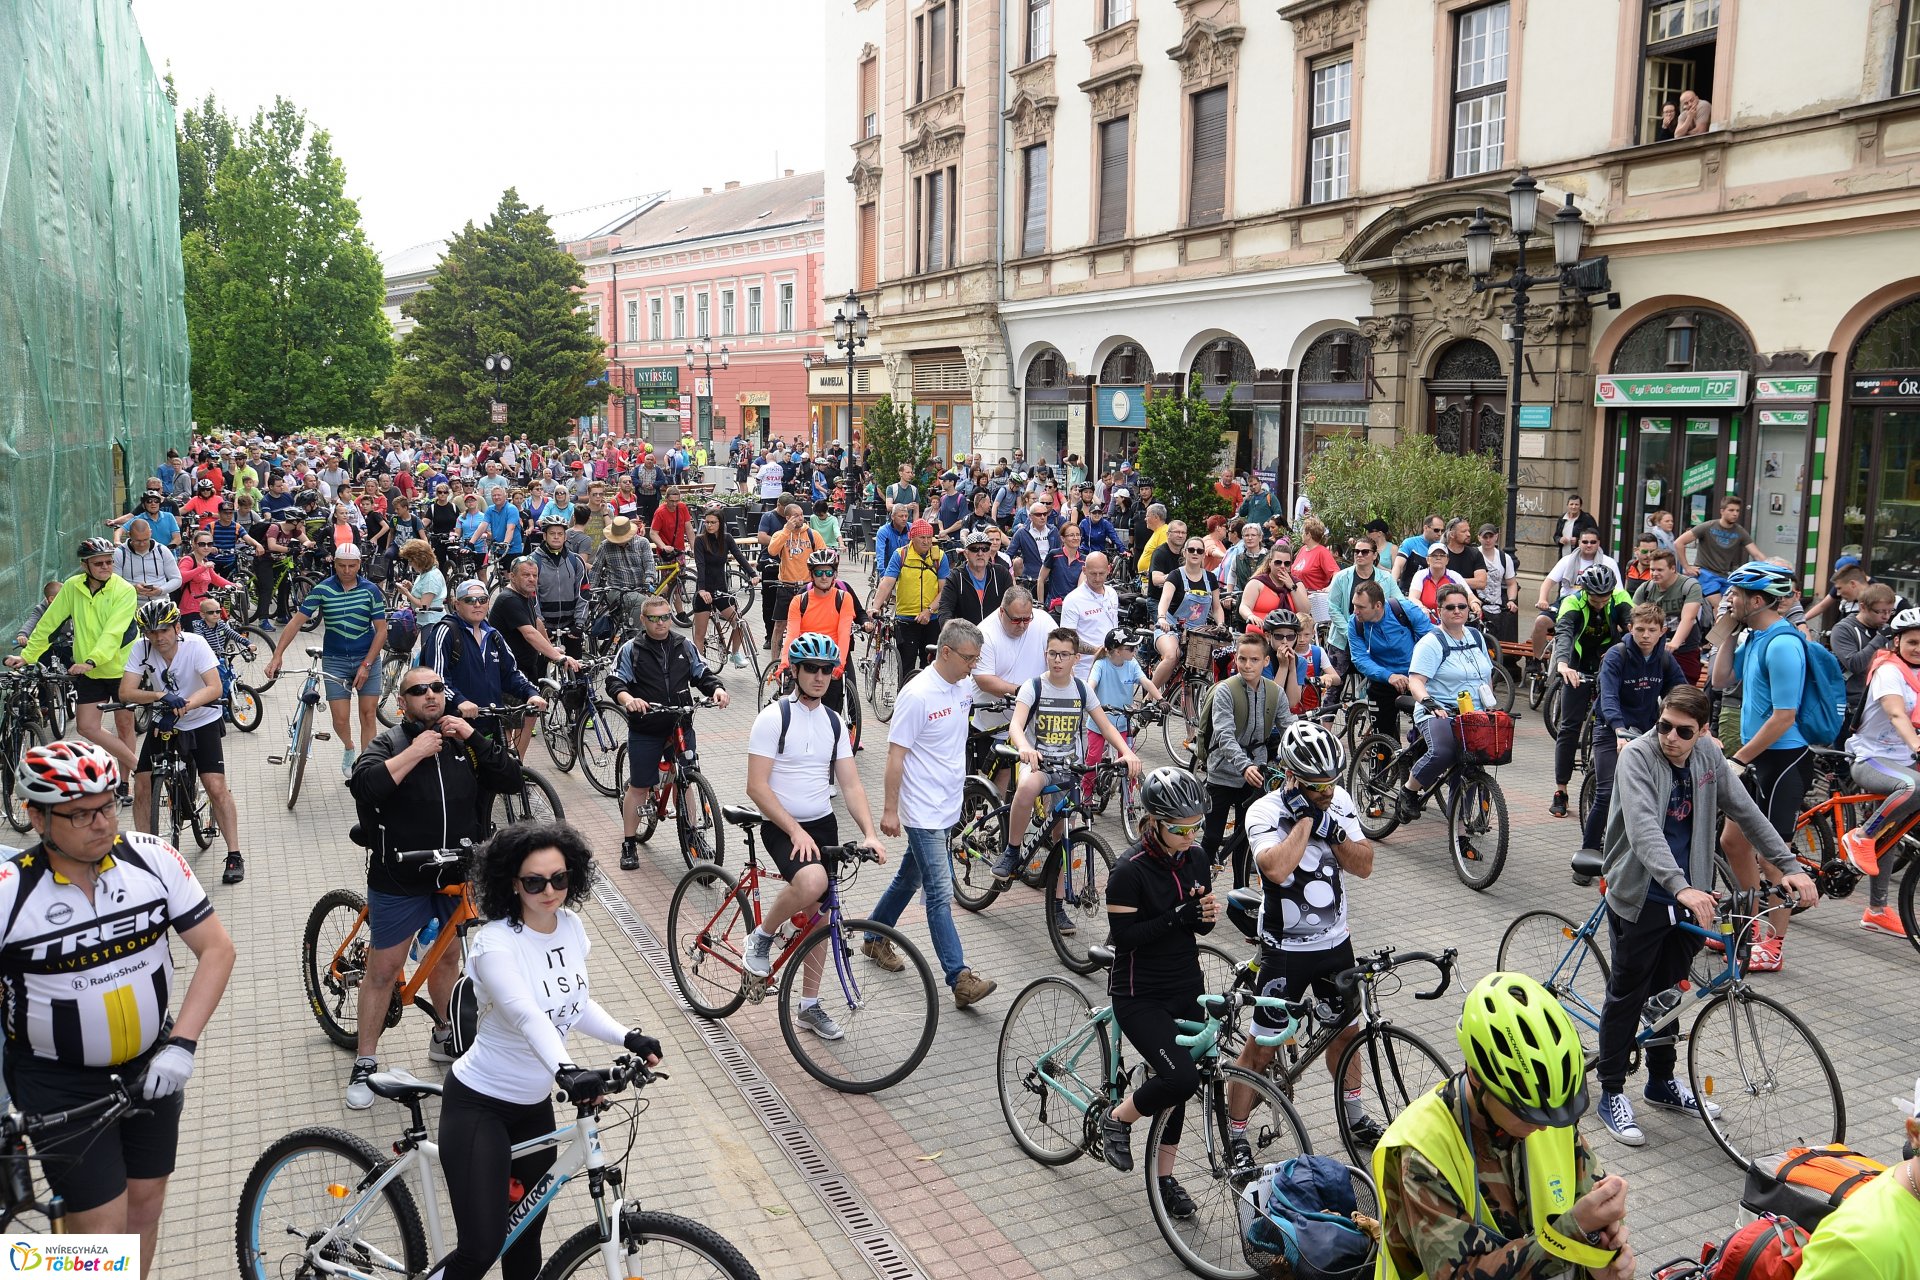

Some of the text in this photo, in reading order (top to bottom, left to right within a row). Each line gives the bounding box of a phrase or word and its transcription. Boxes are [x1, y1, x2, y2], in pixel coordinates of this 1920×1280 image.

[638, 368, 673, 382] NYÍRSÉG
[1665, 383, 1700, 395] Centrum
[1705, 381, 1733, 395] FDF
[1797, 384, 1813, 393] FDF
[1898, 378, 1920, 395] ÓR
[1792, 413, 1806, 421] FDF
[1694, 422, 1709, 430] FDF
[1085, 607, 1102, 616] STAFF
[928, 707, 952, 721] STAFF
[1038, 714, 1080, 733] STREET
[133, 834, 161, 846] THE
[20, 904, 167, 961] TREK
[546, 947, 565, 969] IT
[1505, 1026, 1530, 1074] ROCKRIDER
